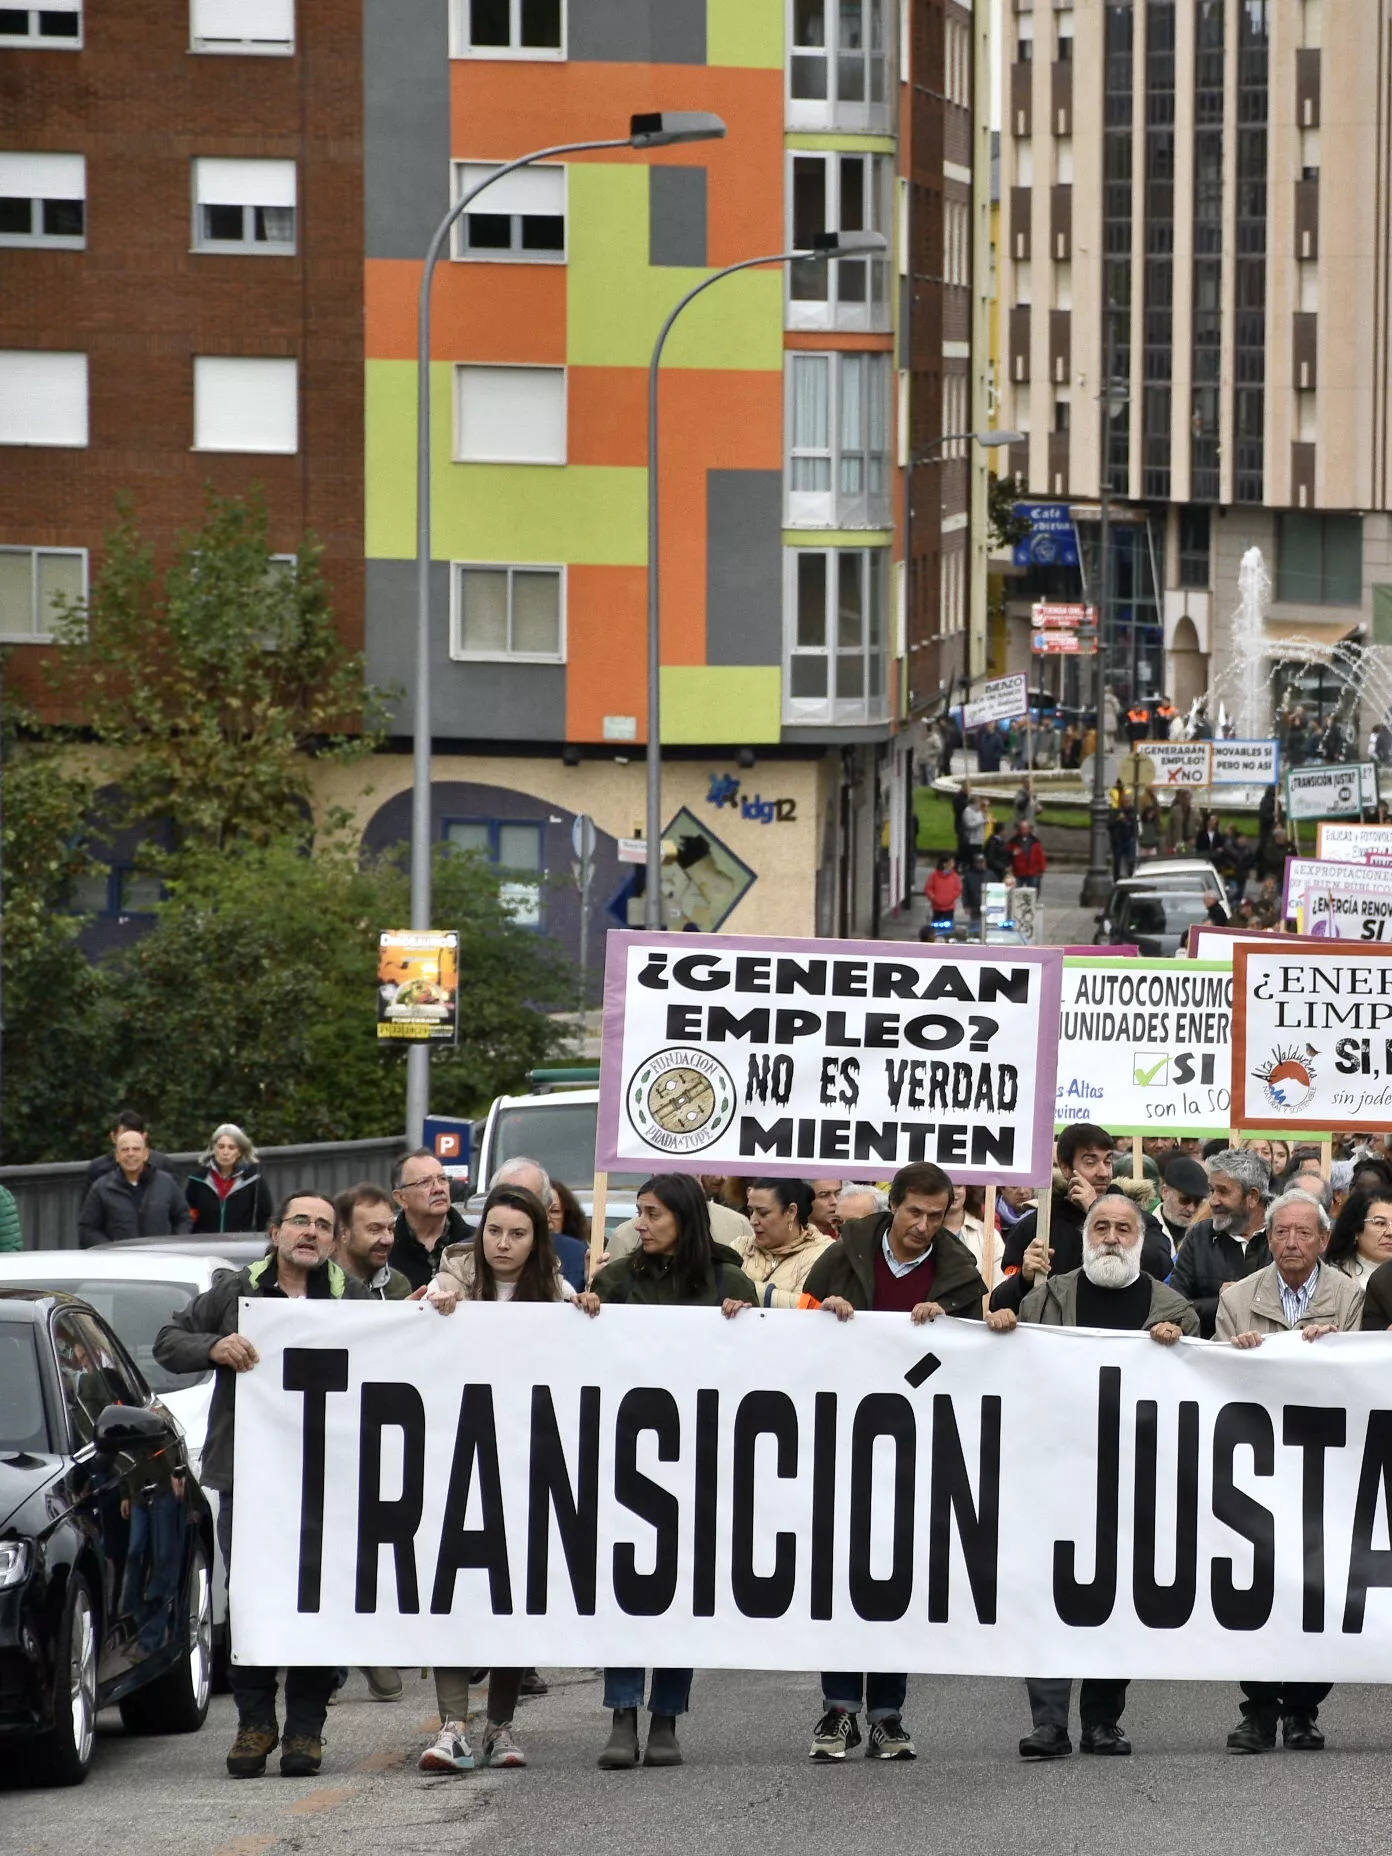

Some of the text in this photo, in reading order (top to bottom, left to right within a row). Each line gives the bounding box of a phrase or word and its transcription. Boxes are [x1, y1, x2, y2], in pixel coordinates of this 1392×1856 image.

[1182, 769, 1203, 781] NO
[1217, 761, 1240, 770] PERO
[1242, 761, 1255, 770] NO
[637, 952, 1030, 1004] ¿GENERAN
[666, 1004, 1000, 1053] EMPLEO?
[1174, 1012, 1233, 1045] ENER
[744, 1052, 1019, 1117] NO ES VERDAD
[1172, 1052, 1216, 1086] SI
[1067, 1078, 1104, 1099] Altas
[1331, 1086, 1358, 1106] sin
[1145, 1103, 1176, 1119] son
[1183, 1092, 1201, 1114] la
[738, 1116, 1014, 1167] MIENTEN
